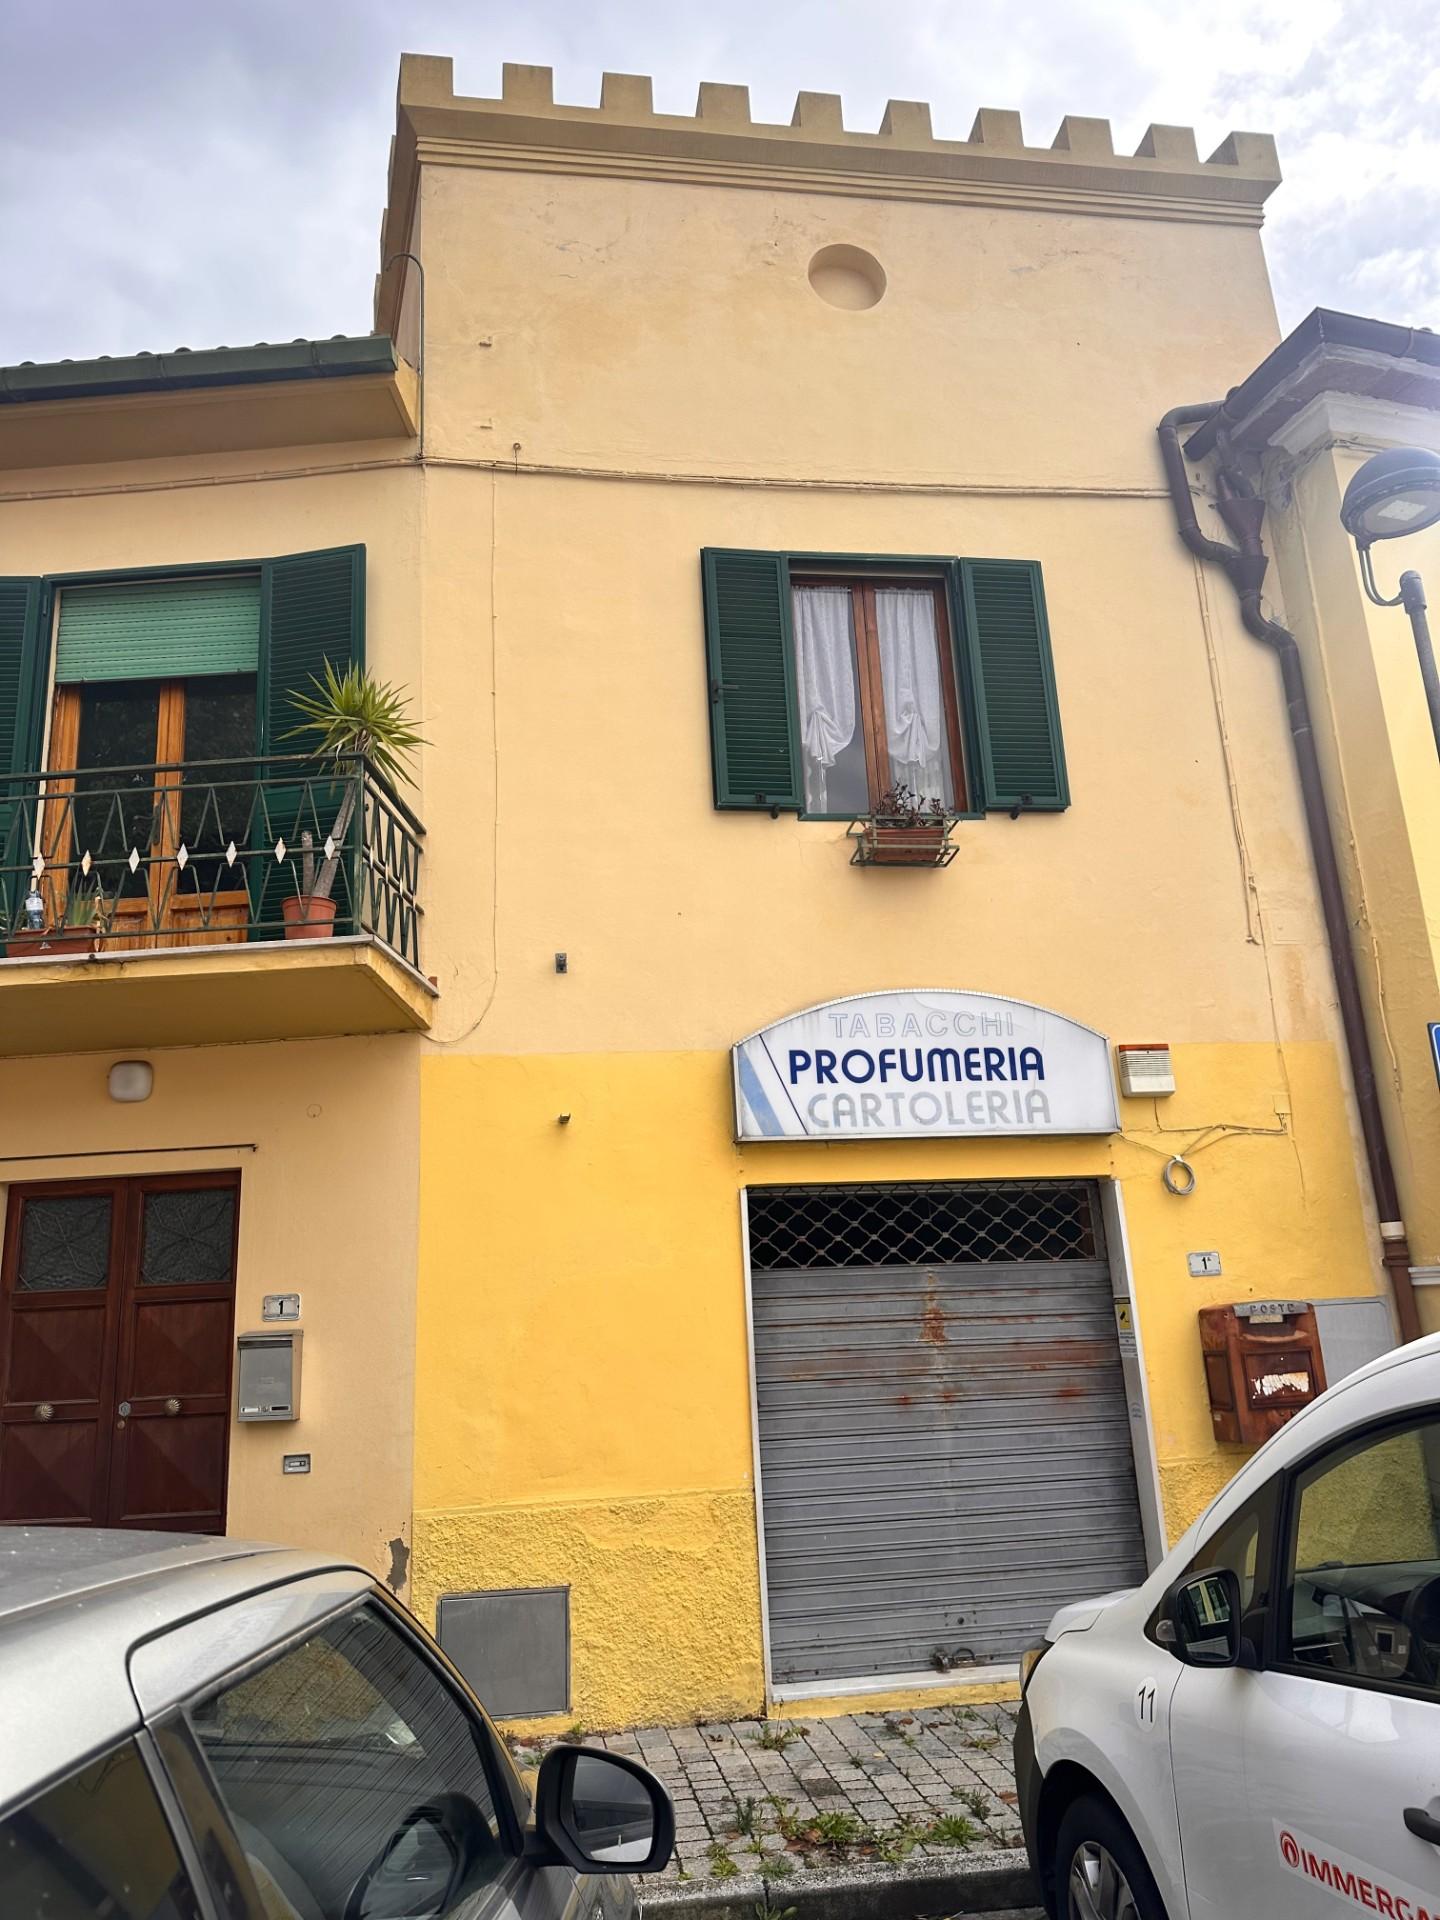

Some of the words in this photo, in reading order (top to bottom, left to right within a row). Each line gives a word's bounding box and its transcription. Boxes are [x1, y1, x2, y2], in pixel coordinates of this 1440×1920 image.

[829, 1011, 1014, 1038] TABACCHI
[788, 1046, 1045, 1084] PROFUMERIA
[807, 1089, 1051, 1128] CARTOLERIA
[278, 1300, 285, 1314] 1
[1250, 1303, 1295, 1314] POSTE
[1138, 1685, 1156, 1723] 11
[1300, 1847, 1440, 1920] IMMERG
